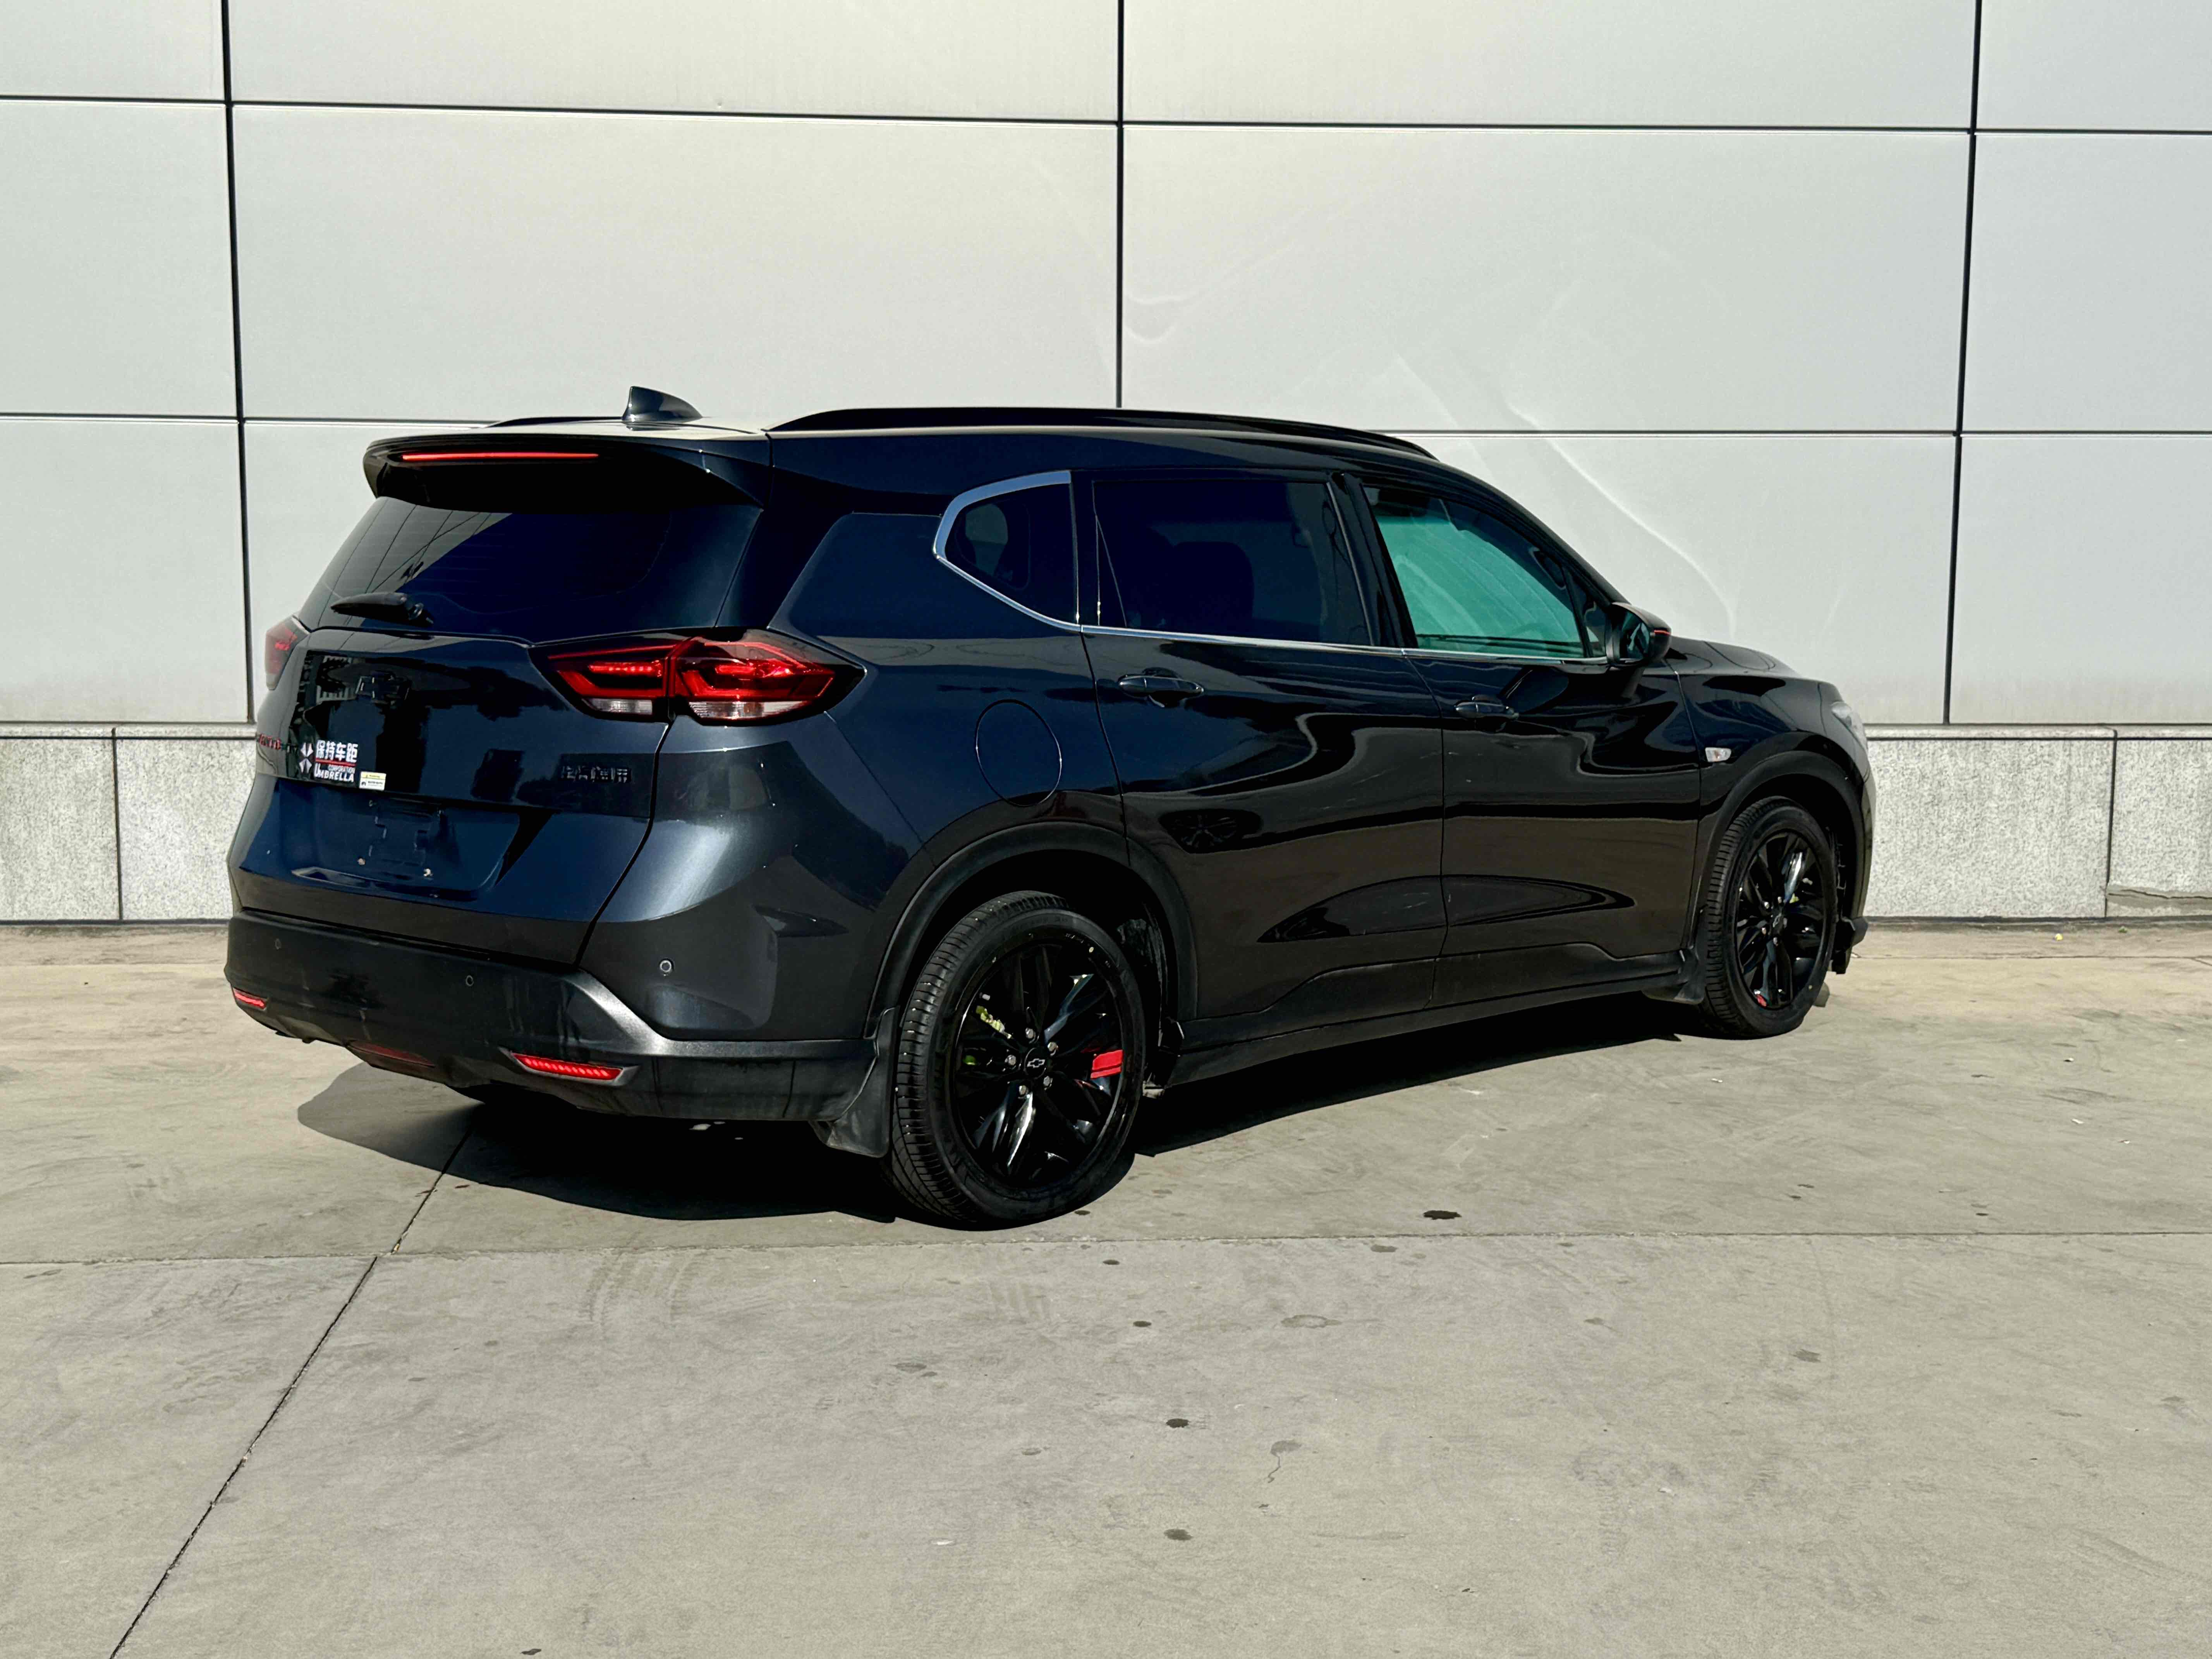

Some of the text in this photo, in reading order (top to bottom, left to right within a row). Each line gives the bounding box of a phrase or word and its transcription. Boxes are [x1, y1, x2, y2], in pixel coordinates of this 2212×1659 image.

[316, 740, 358, 763] 保持车距
[313, 763, 354, 782] UMBRELLA
